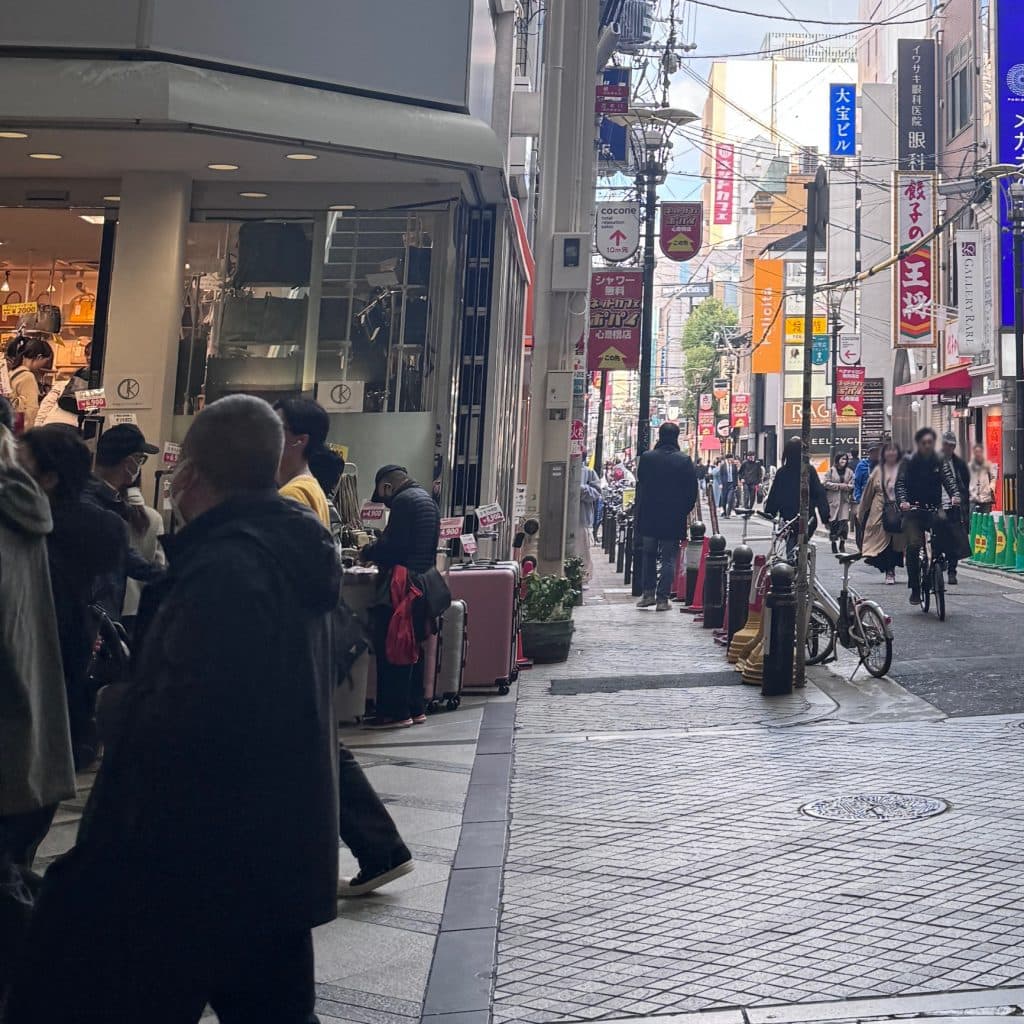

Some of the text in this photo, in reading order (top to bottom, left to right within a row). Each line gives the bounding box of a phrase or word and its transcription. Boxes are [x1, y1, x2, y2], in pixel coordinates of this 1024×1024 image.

[835, 87, 850, 152] 大宝ビル
[908, 131, 925, 171] 眼科
[601, 207, 637, 215] cocone
[595, 275, 636, 285] シャワー
[811, 437, 831, 445] EEL
